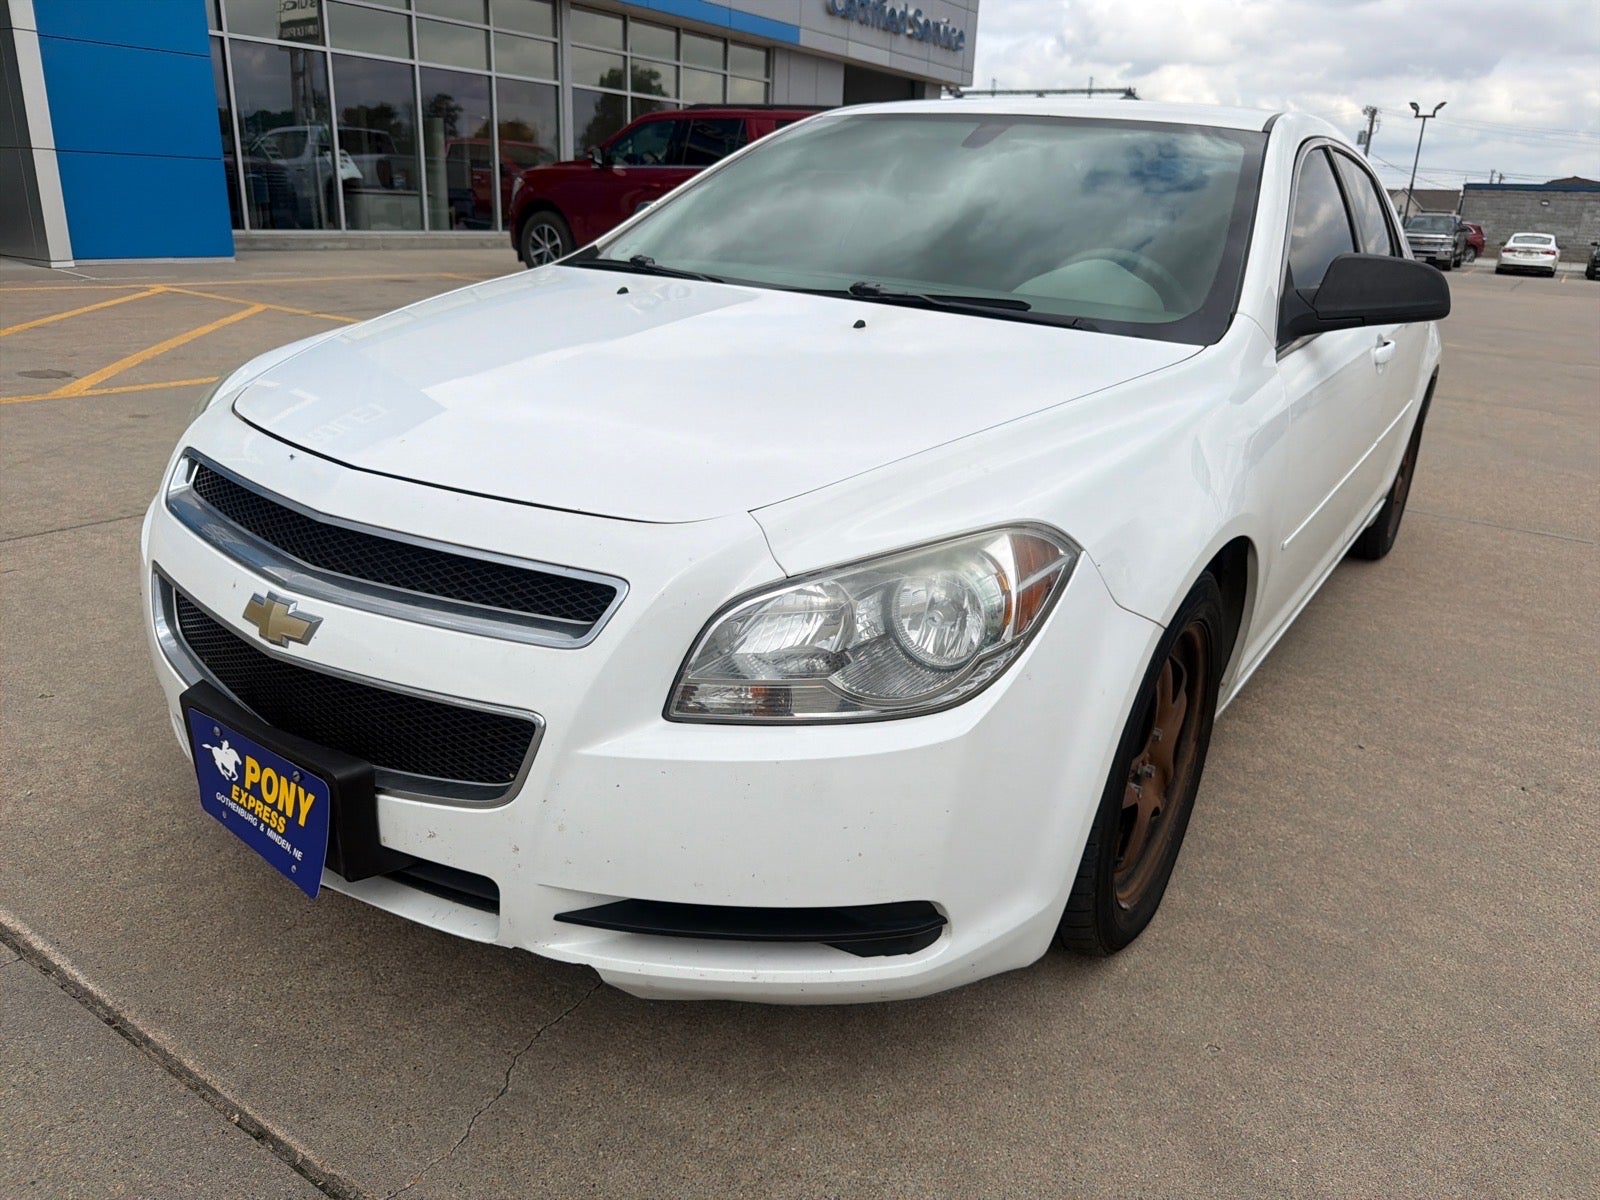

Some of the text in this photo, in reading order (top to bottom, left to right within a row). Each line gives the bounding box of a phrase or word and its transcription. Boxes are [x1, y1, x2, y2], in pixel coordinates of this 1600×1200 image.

[912, 9, 965, 51] Service
[231, 784, 286, 833] EXPRESS
[245, 755, 315, 827] PONY
[216, 792, 304, 861] GOTHENBURG & MINDEN, NE
